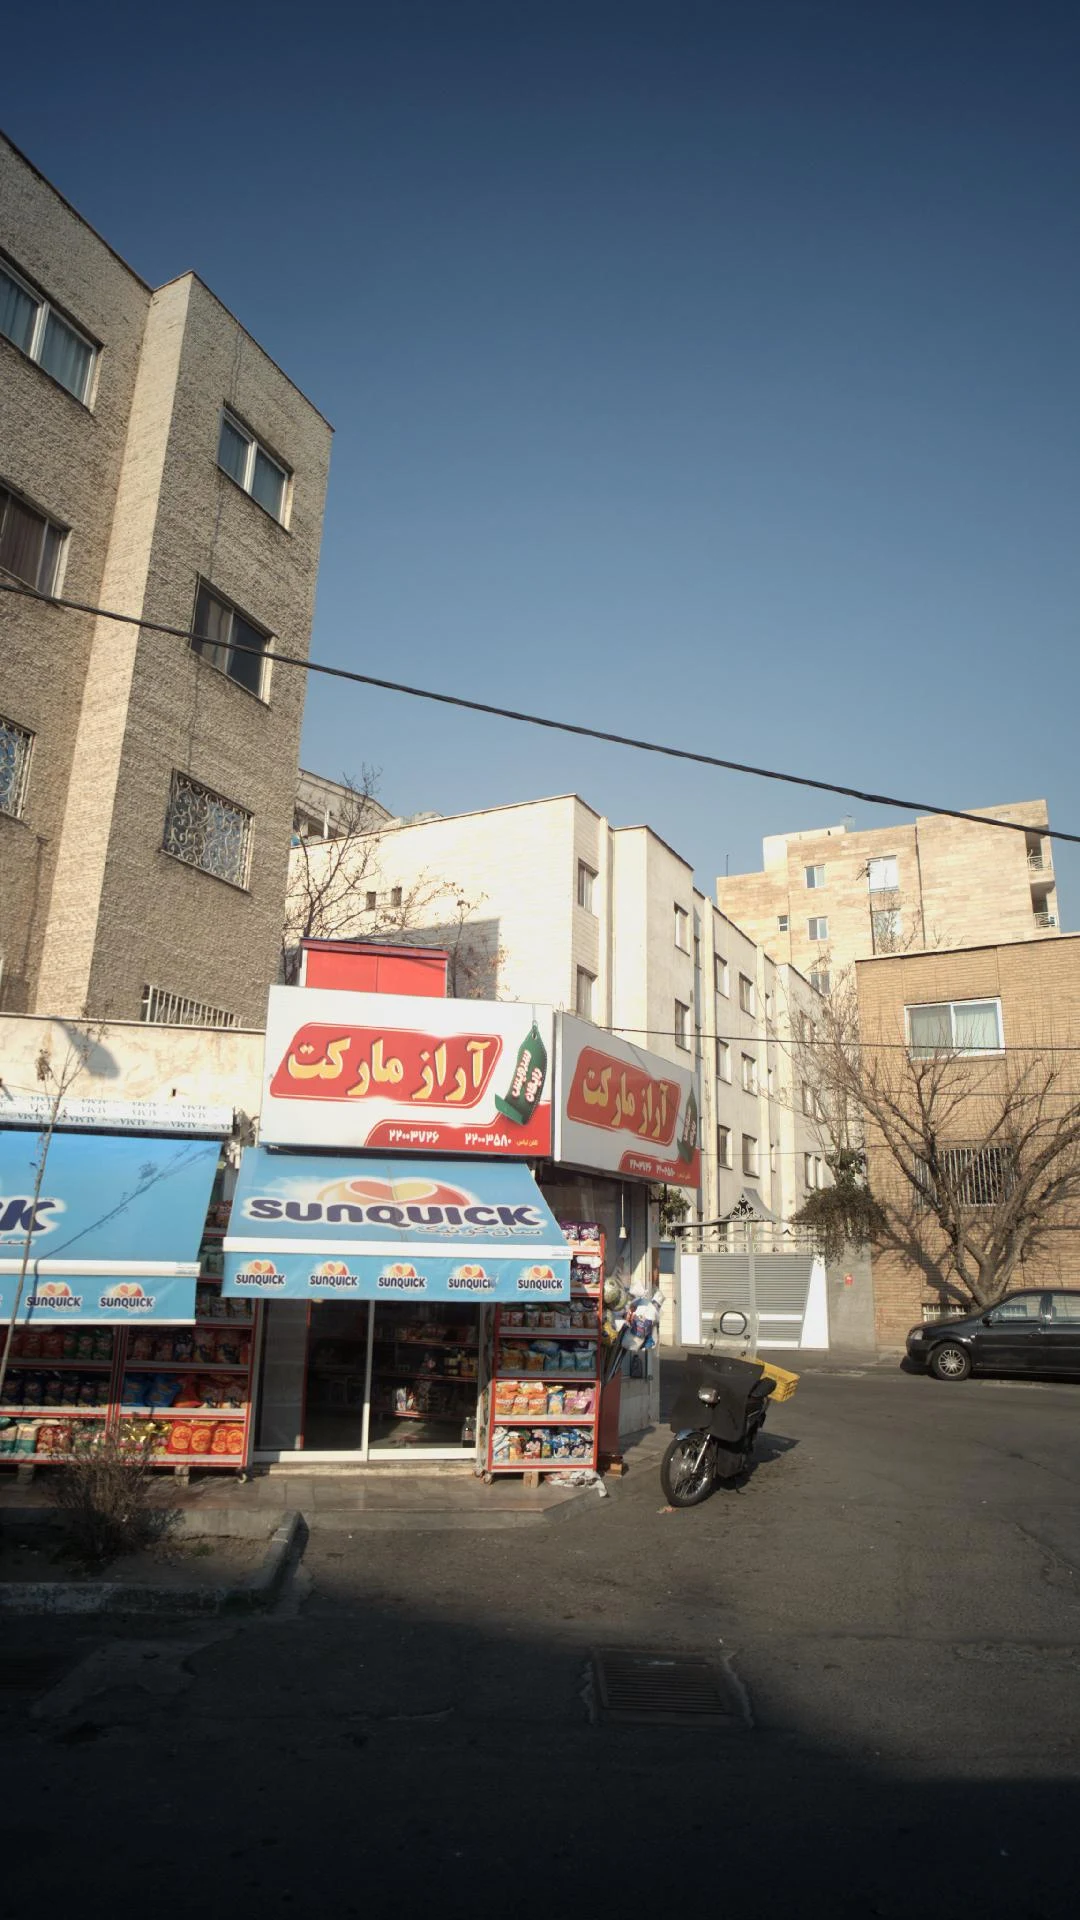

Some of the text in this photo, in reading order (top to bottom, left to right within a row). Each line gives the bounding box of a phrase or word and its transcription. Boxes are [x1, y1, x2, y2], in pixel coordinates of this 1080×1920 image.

[287, 1037, 491, 1101] آراز مارکت
[582, 1065, 635, 1127] مارکت
[638, 1081, 669, 1138] آراز
[249, 1199, 540, 1228] SUNQUICK
[235, 1274, 285, 1285] SUNQUICK
[310, 1275, 358, 1286] SUNQUICK
[378, 1277, 426, 1288] SUNQUICK
[518, 1279, 563, 1290] SUNQUICK
[26, 1297, 81, 1308] SUNQUICK
[100, 1297, 153, 1308] SUNQUICK
